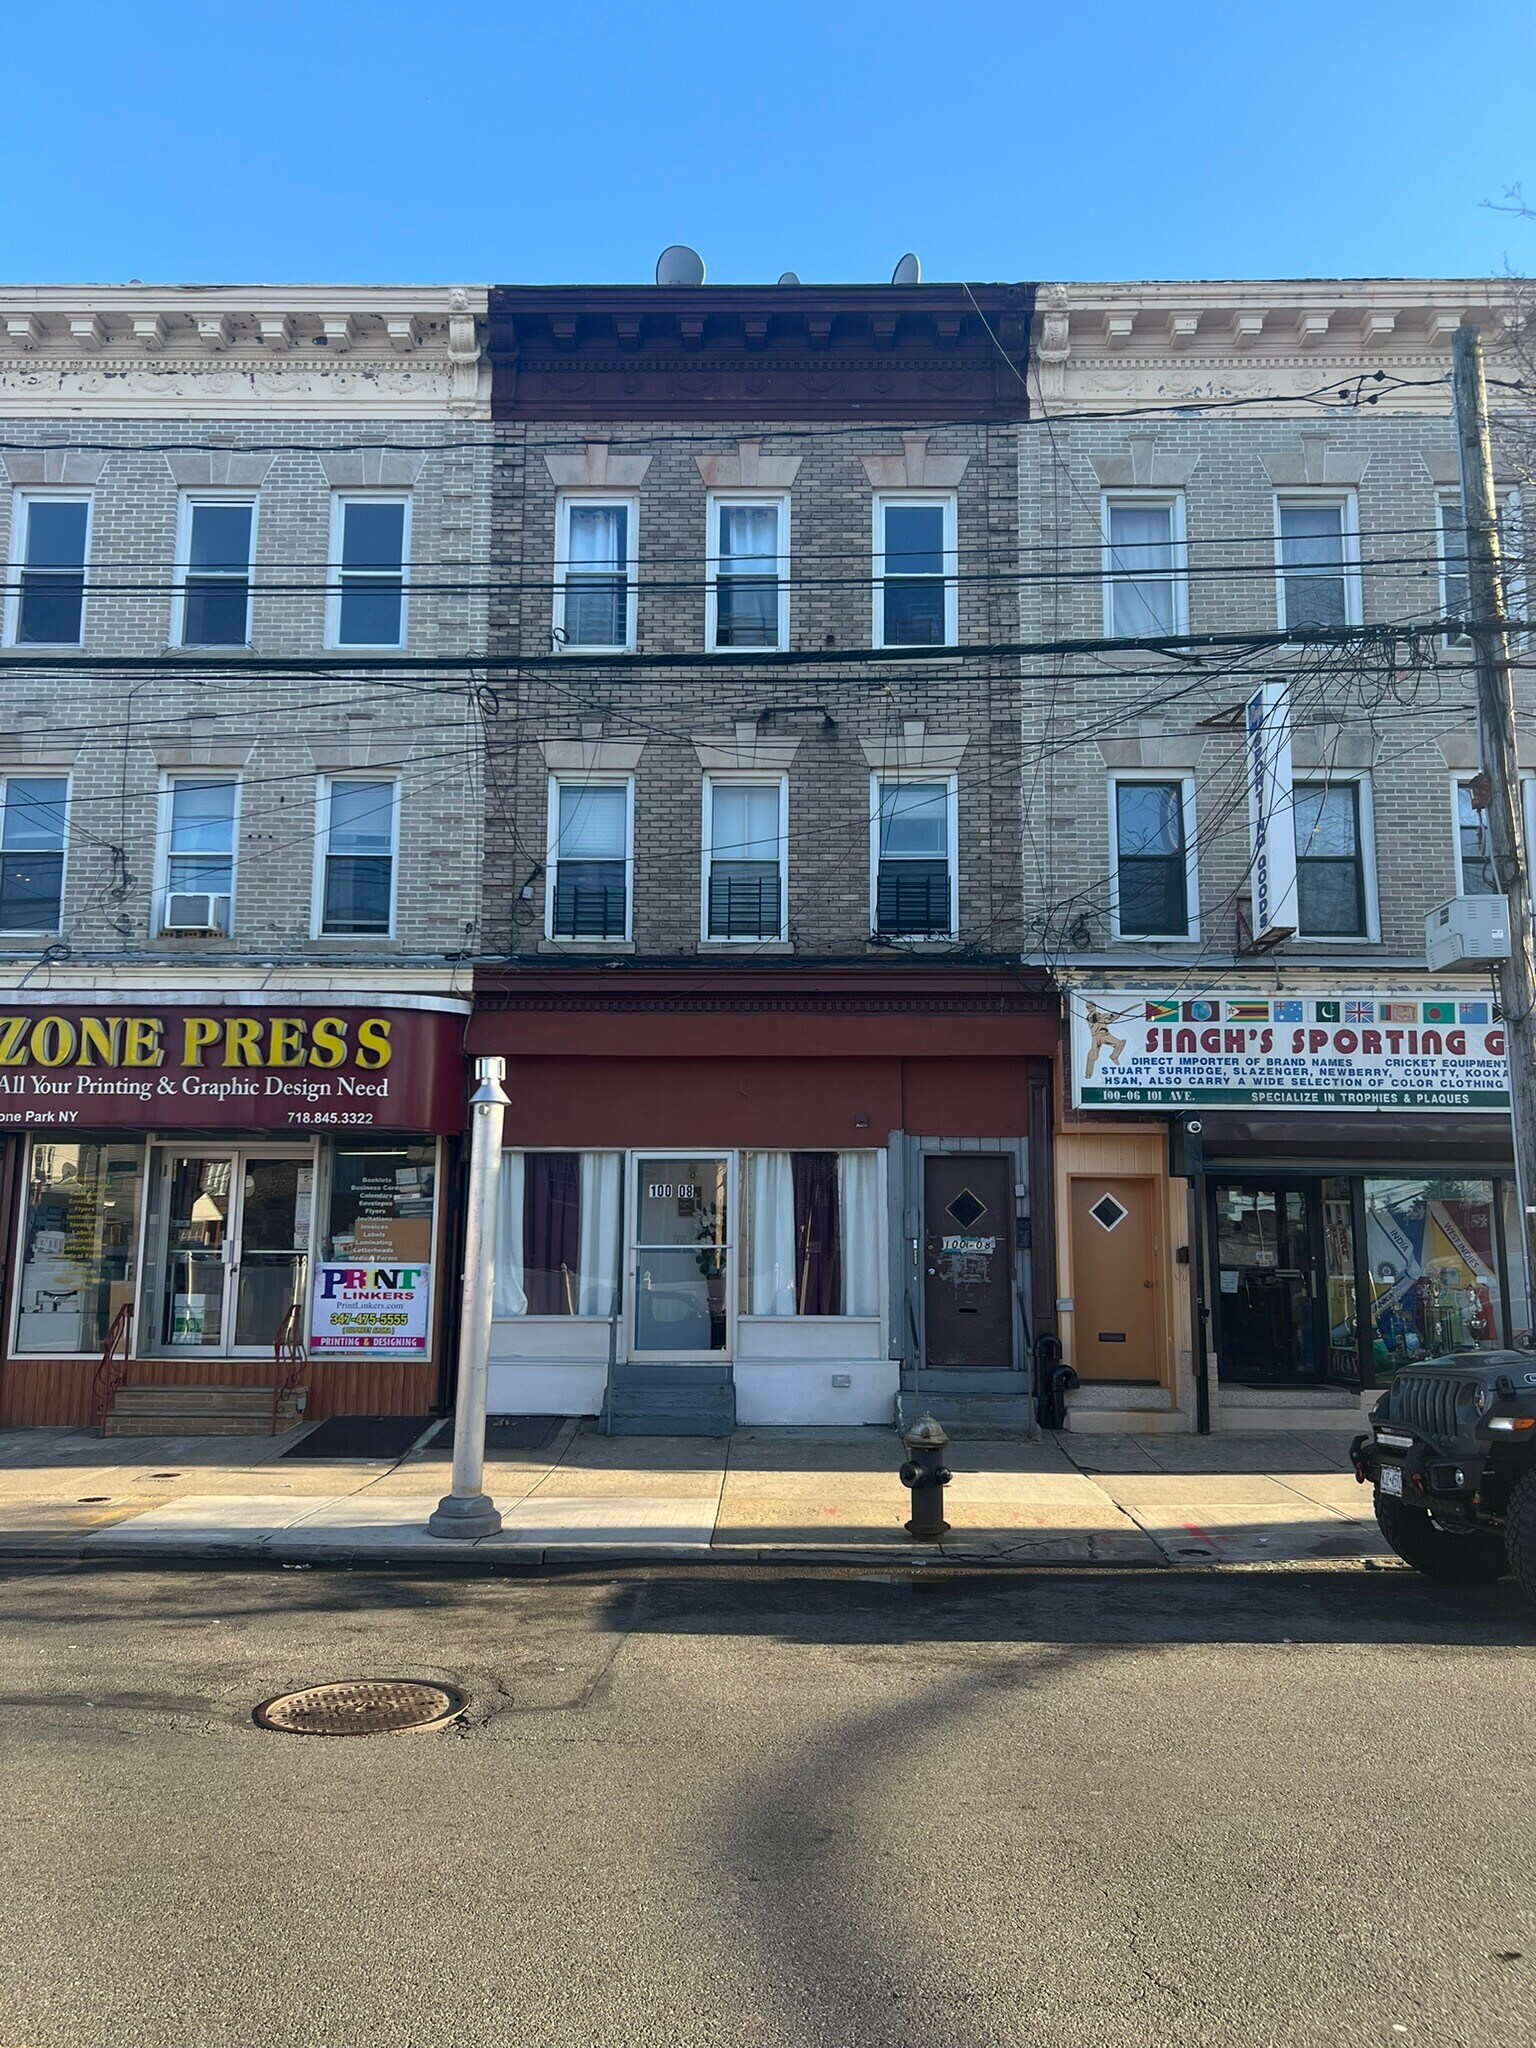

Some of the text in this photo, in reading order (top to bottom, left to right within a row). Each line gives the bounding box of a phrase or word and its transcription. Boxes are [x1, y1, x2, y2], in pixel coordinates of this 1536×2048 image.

[1257, 854, 1269, 929] GOODS
[0, 1016, 393, 1069] ZONE PRESS
[1145, 1028, 1273, 1054] SINGH'S
[1292, 1028, 1466, 1055] SPORTING
[1131, 1057, 1508, 1068] DIRECT IMPORTER OF BRAND NAMES CRICKET EQUIPMENT
[1101, 1067, 1151, 1075] STUART
[1158, 1067, 1227, 1077] SURRIDGE,
[1233, 1067, 1314, 1077] SLAZENGER,
[1319, 1068, 1393, 1078] NEWBERRY,
[1404, 1068, 1459, 1079] COUNTY,
[0, 1074, 389, 1102] All Your Printing & Graphic Design Need
[1104, 1076, 1504, 1088] HSAN, ALSO CARRY A WIDE SELECTION OF COLOR CLOTHING
[1103, 1090, 1469, 1104] 100-06 101 AVE. SPECIALIZE IN TROPHIES & PLAQUES
[25, 1110, 55, 1122] Park
[58, 1111, 79, 1122] NY
[287, 1112, 373, 1125] 718.845.3322
[651, 1184, 693, 1197] 100 08
[1389, 1229, 1409, 1253] INDIA
[1443, 1222, 1480, 1269] WEST INDIES
[320, 1269, 422, 1299] PRINT
[342, 1292, 415, 1300] LINKERS
[336, 1301, 404, 1310] PrintLinkers.com
[330, 1312, 409, 1326] 347-475-5555
[320, 1337, 417, 1346] PRINTING & DESIGNING
